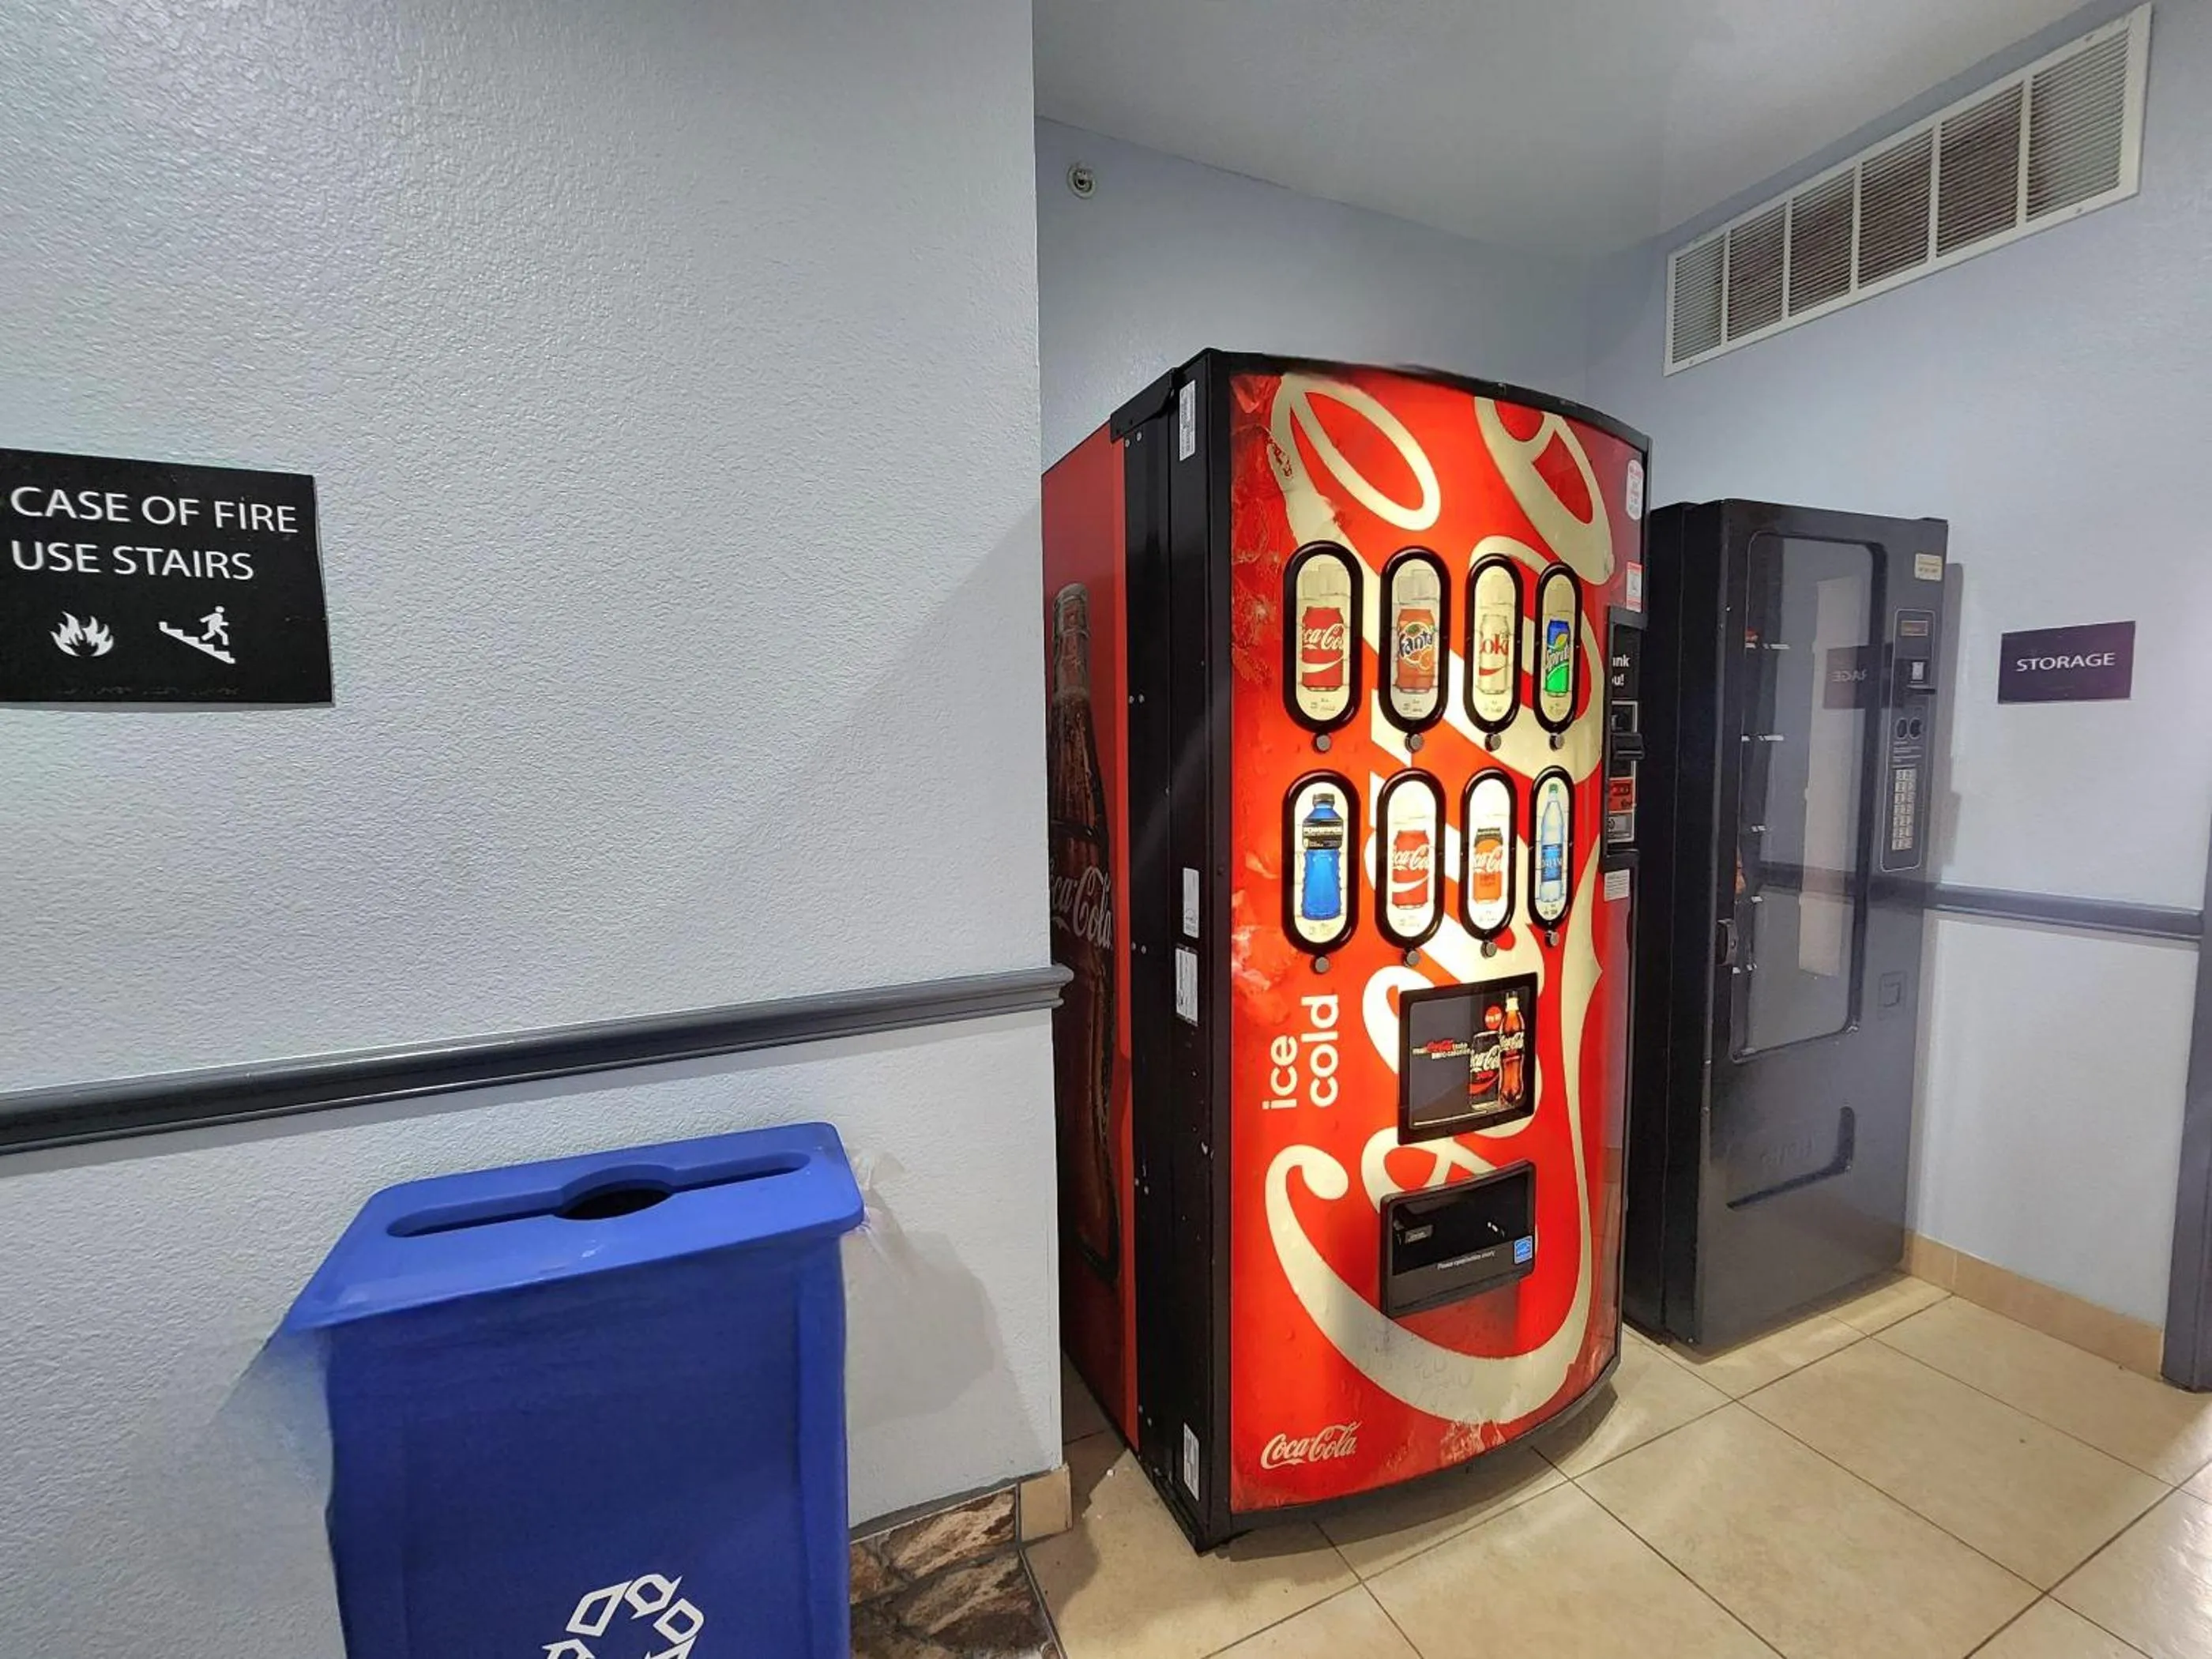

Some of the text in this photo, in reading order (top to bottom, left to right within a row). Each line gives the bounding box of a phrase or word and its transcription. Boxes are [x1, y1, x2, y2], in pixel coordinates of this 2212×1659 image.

[10, 487, 299, 533] CASE OF FIRE
[11, 540, 254, 581] USE STAIRS
[2015, 652, 2116, 672] STORAGE
[1262, 1034, 1297, 1110] ice
[1301, 994, 1339, 1108] cold
